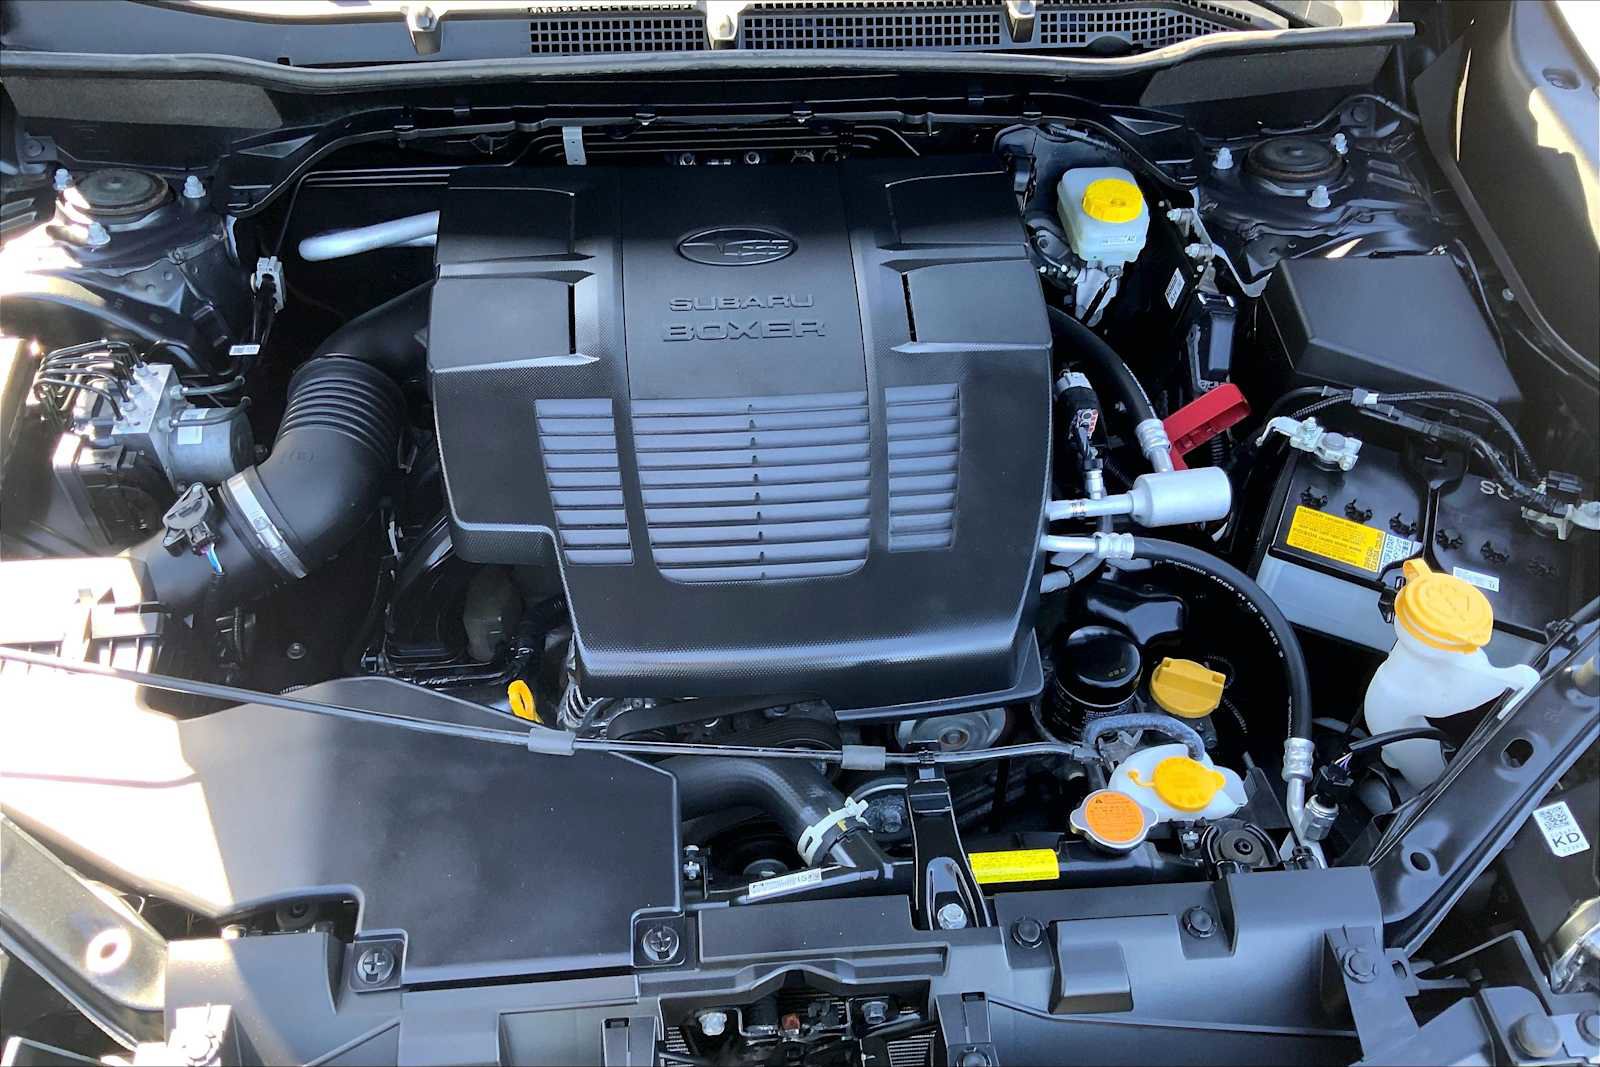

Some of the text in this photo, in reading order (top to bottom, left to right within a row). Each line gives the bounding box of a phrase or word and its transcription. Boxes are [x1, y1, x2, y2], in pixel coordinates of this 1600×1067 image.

[669, 294, 814, 311] SUBARU
[663, 320, 826, 342] BOXER
[1552, 832, 1580, 848] KD
